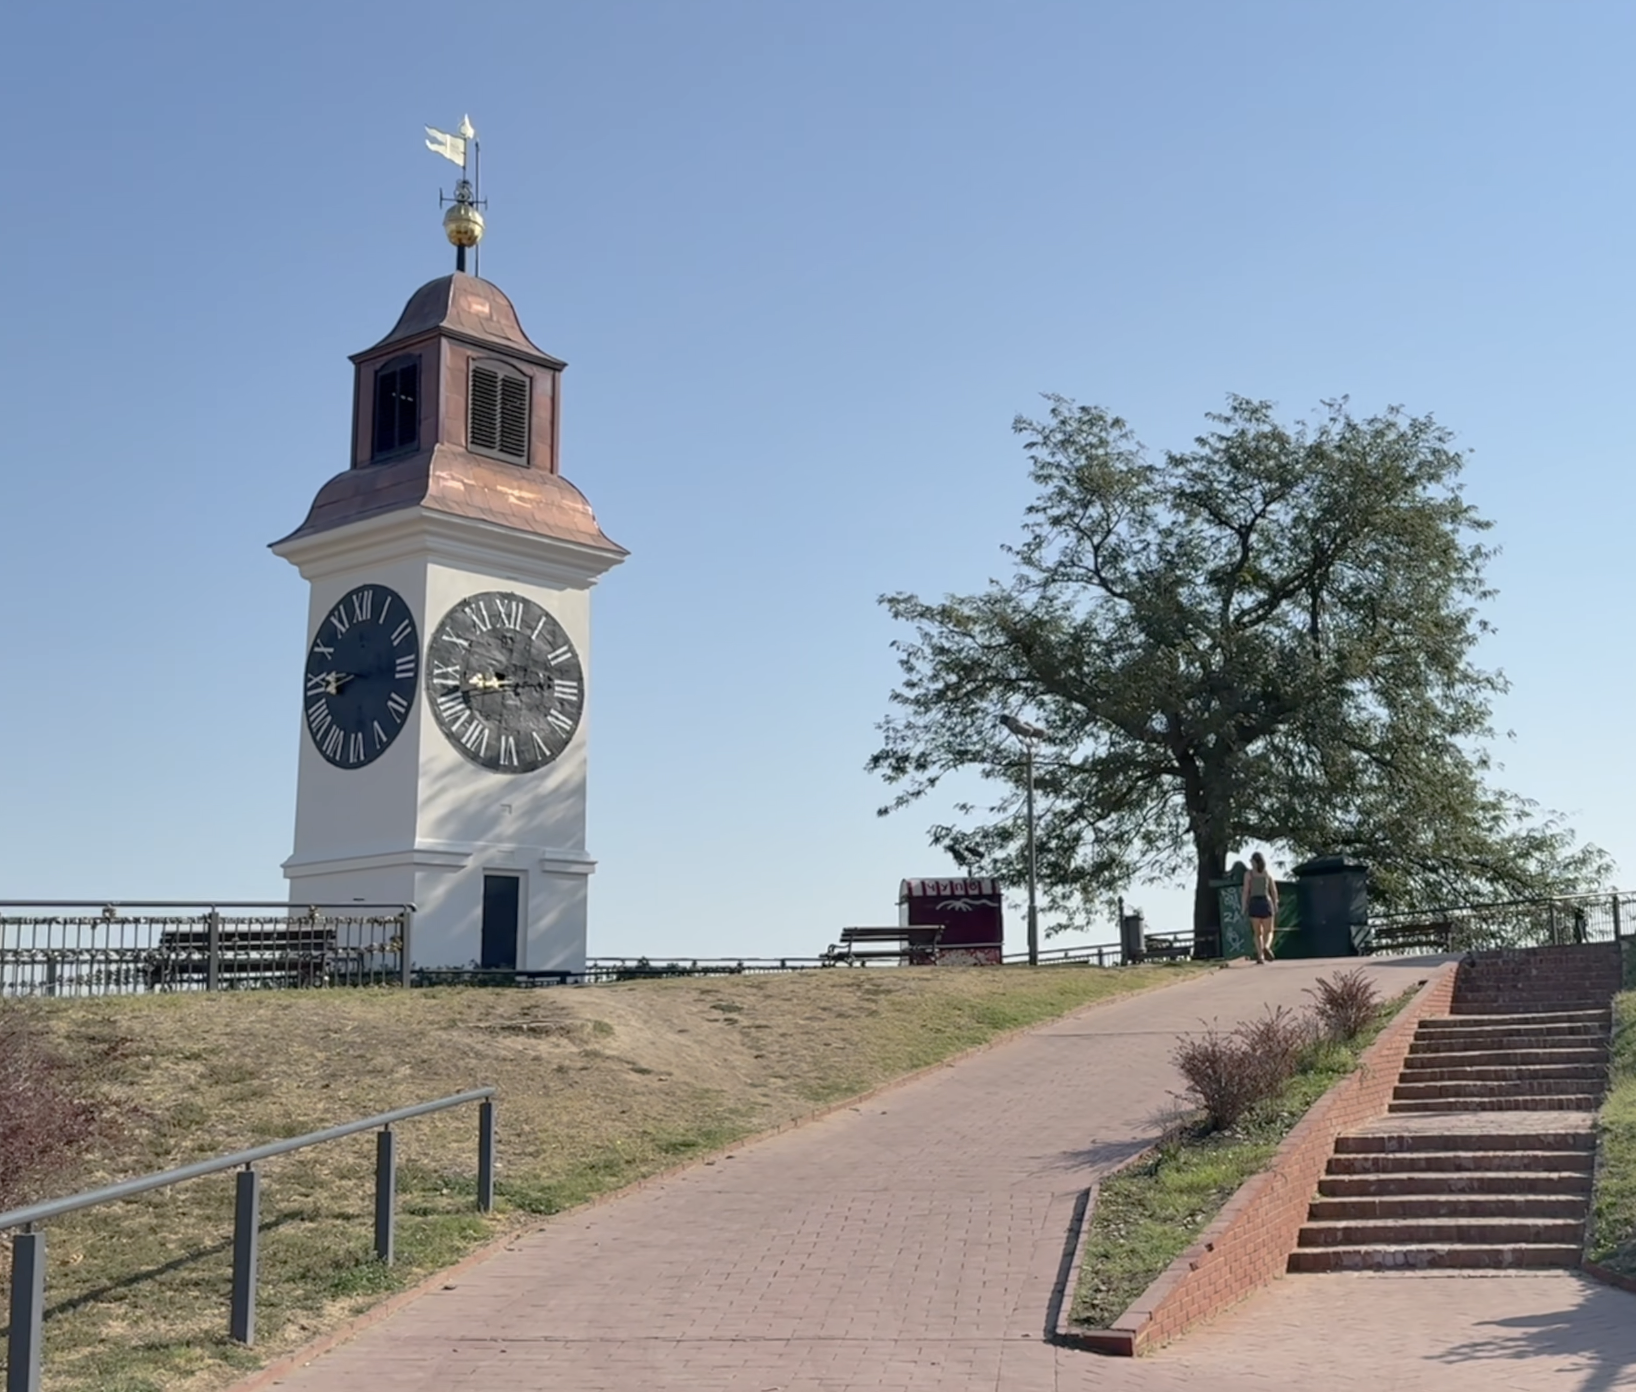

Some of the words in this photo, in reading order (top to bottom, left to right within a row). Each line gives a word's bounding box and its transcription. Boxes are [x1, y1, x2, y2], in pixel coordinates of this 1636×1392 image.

[352, 590, 373, 623] XII
[379, 596, 392, 624] I
[464, 601, 492, 635] XI
[496, 599, 523, 631] XII
[330, 604, 350, 639] XI
[391, 618, 412, 647] II
[531, 616, 546, 640] I
[313, 638, 335, 660] X
[442, 626, 471, 654] X
[395, 654, 415, 679] III
[547, 645, 572, 666] II
[433, 660, 461, 685] IX
[554, 680, 578, 701] III
[386, 692, 408, 723] IV
[373, 720, 388, 749] V
[547, 708, 573, 739] IV
[350, 732, 365, 763] VI
[499, 735, 518, 766] VI
[532, 731, 551, 761] V
